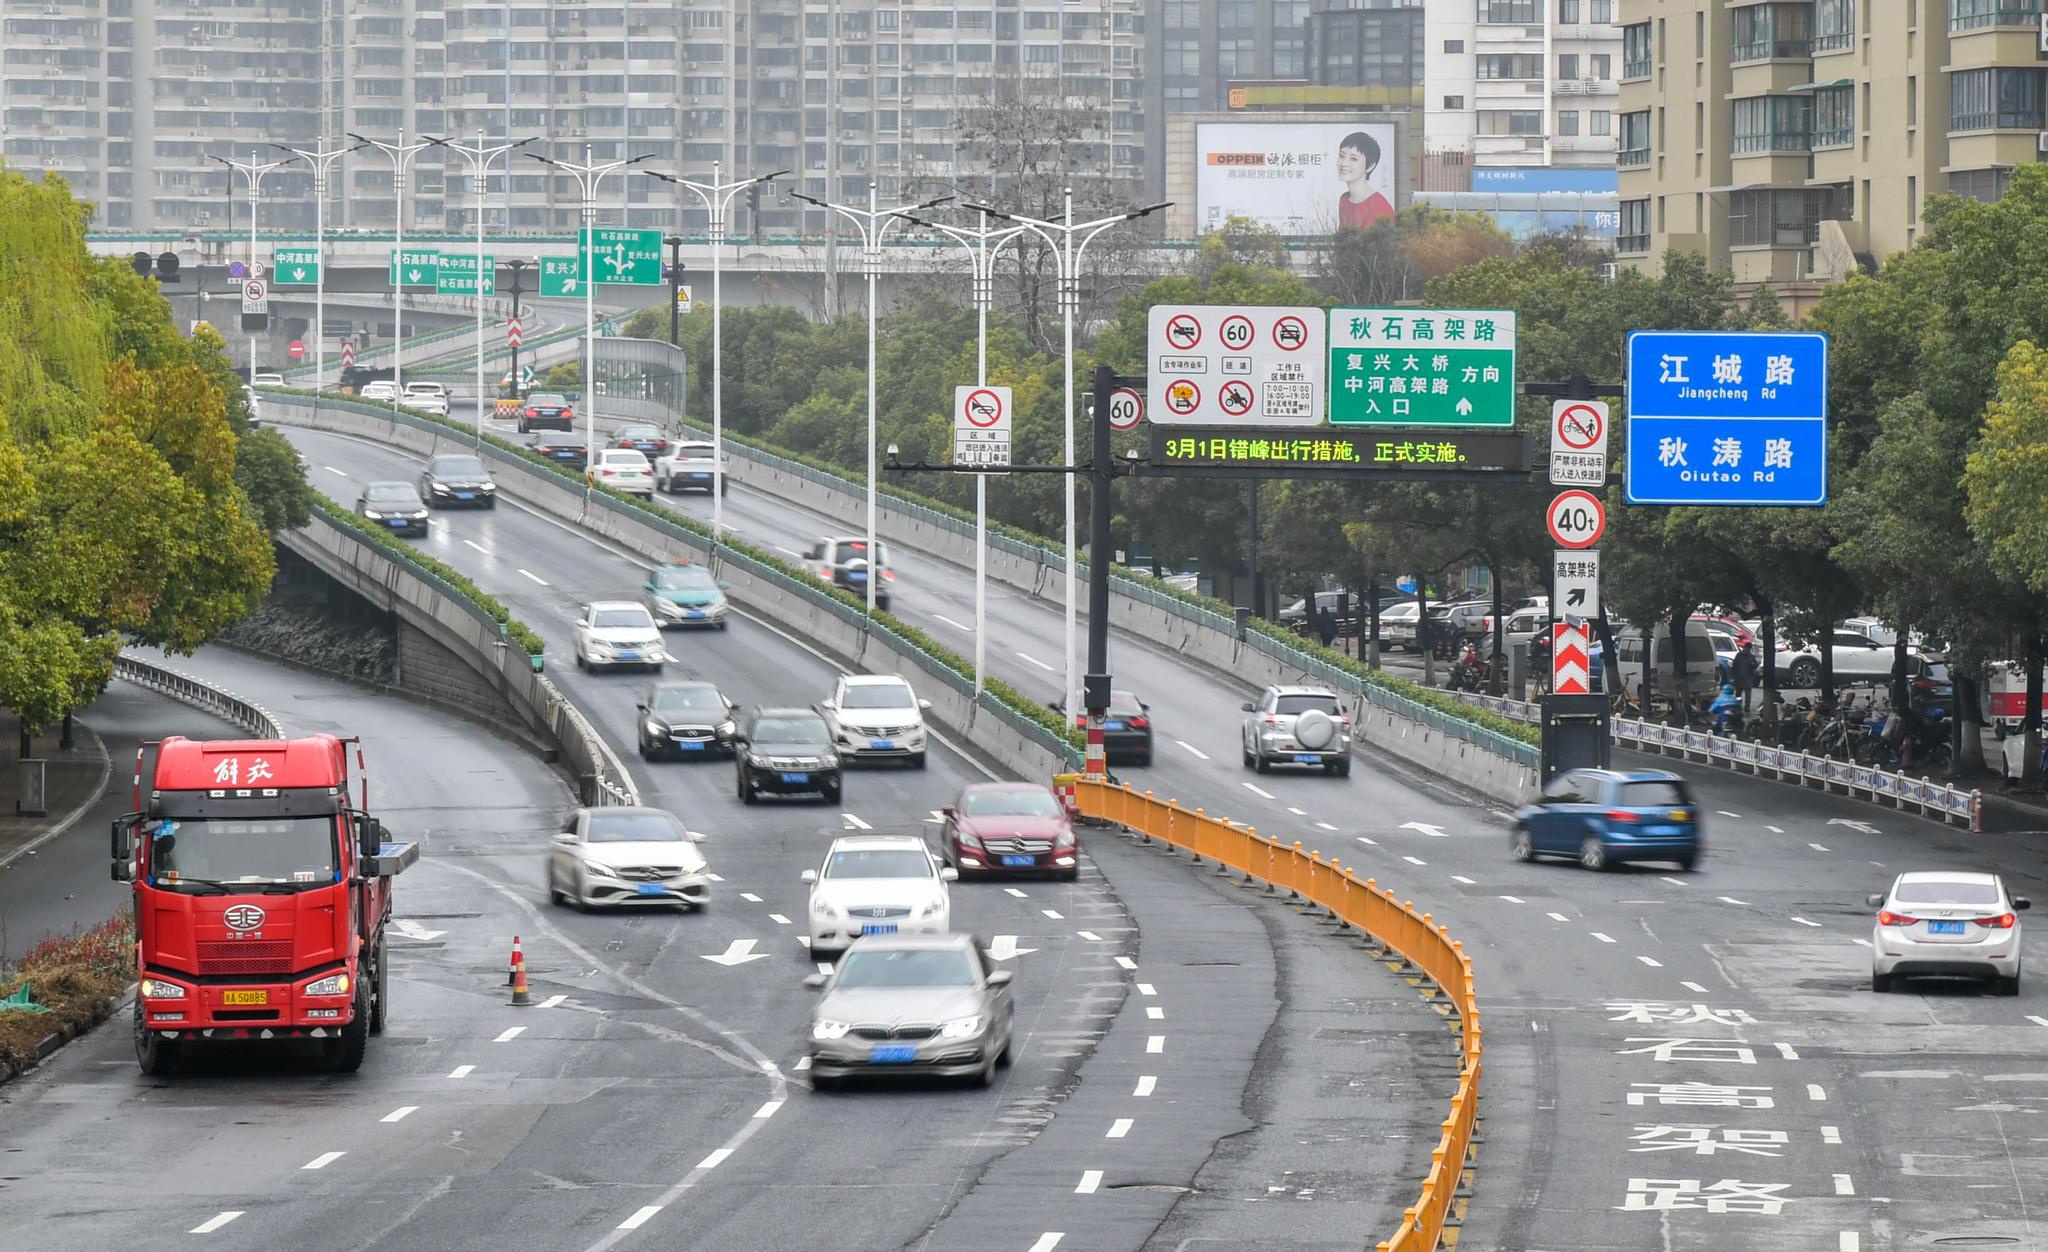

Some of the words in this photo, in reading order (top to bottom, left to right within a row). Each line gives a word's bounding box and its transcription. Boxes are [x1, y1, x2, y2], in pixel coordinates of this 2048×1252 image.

[1217, 155, 1264, 165] OPPEIN
[601, 232, 639, 242] 秋石高架路
[580, 245, 612, 254] 中高架路
[628, 251, 659, 260] 复兴大桥
[450, 258, 492, 270] 中河高路
[1226, 325, 1247, 341] 60
[1350, 317, 1496, 341] 秋石高架路
[1163, 361, 1203, 369] 含专项作业车
[1276, 363, 1301, 372] 工作日
[1346, 354, 1449, 372] 复兴大桥
[1659, 354, 1795, 385] 江城路
[1271, 373, 1304, 381] 区域禁行
[1461, 365, 1500, 384] 方向
[1344, 376, 1449, 395] 中河高架路
[1678, 387, 1748, 401] Jiangcheng
[1761, 388, 1776, 399] Rd
[1111, 400, 1134, 419] 60
[1366, 398, 1410, 415] 入口
[970, 431, 996, 440] 区域
[1658, 437, 1794, 468] 秋涛路
[1554, 455, 1603, 467] 严禁非机动车
[1553, 468, 1602, 480] 行人进入快速路
[1680, 470, 1741, 482] Qiutao
[1753, 471, 1775, 482] Rd
[1558, 508, 1595, 531] 40t
[1557, 562, 1596, 578] 高架禁货
[213, 757, 273, 785] 解放
